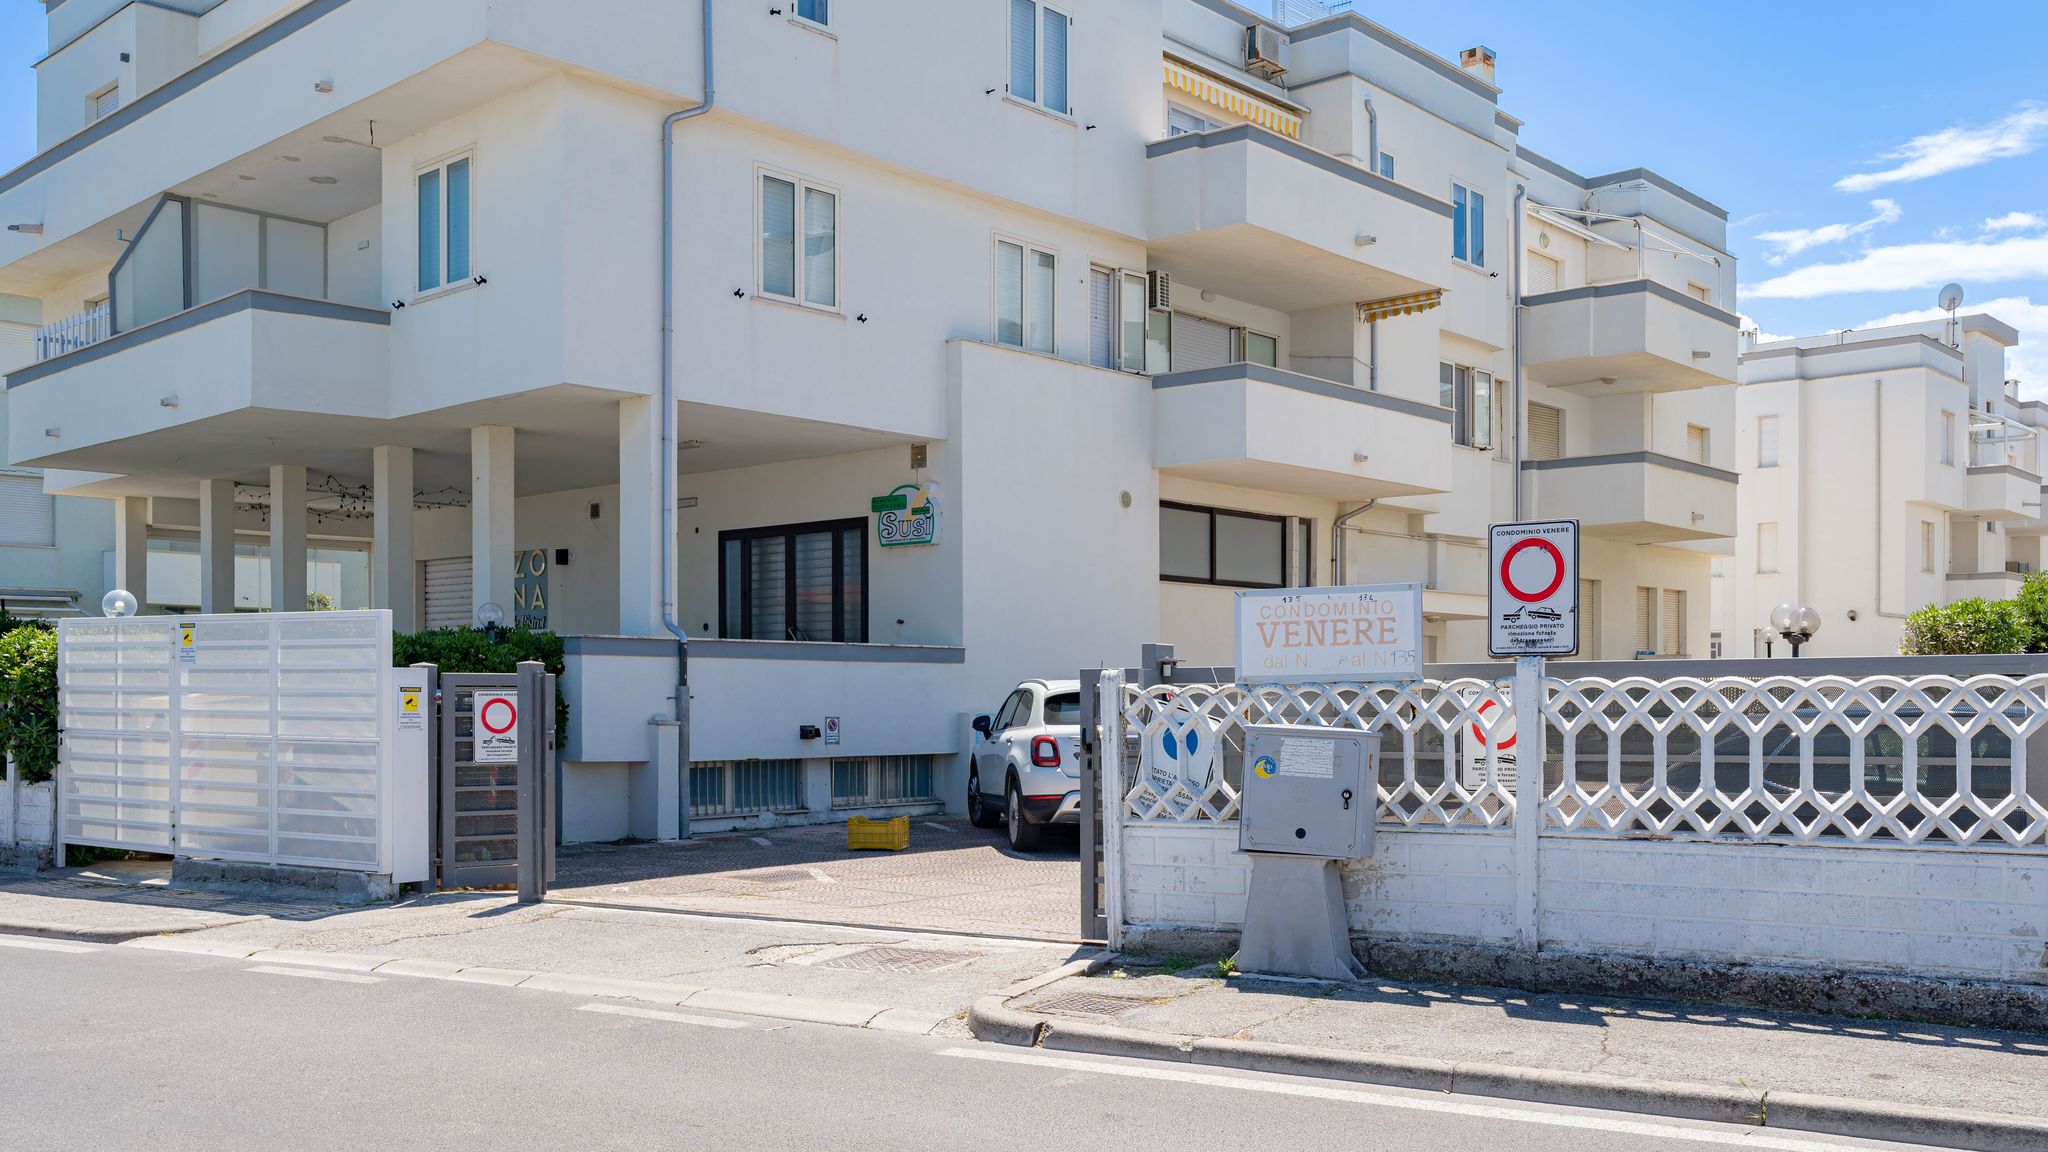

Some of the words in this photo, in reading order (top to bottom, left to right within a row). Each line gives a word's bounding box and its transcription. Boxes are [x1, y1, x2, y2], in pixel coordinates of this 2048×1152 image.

[1260, 600, 1394, 619] CONDOMINIO
[1256, 617, 1398, 649] VENERE
[1264, 654, 1288, 669] dal
[1352, 653, 1366, 667] al
